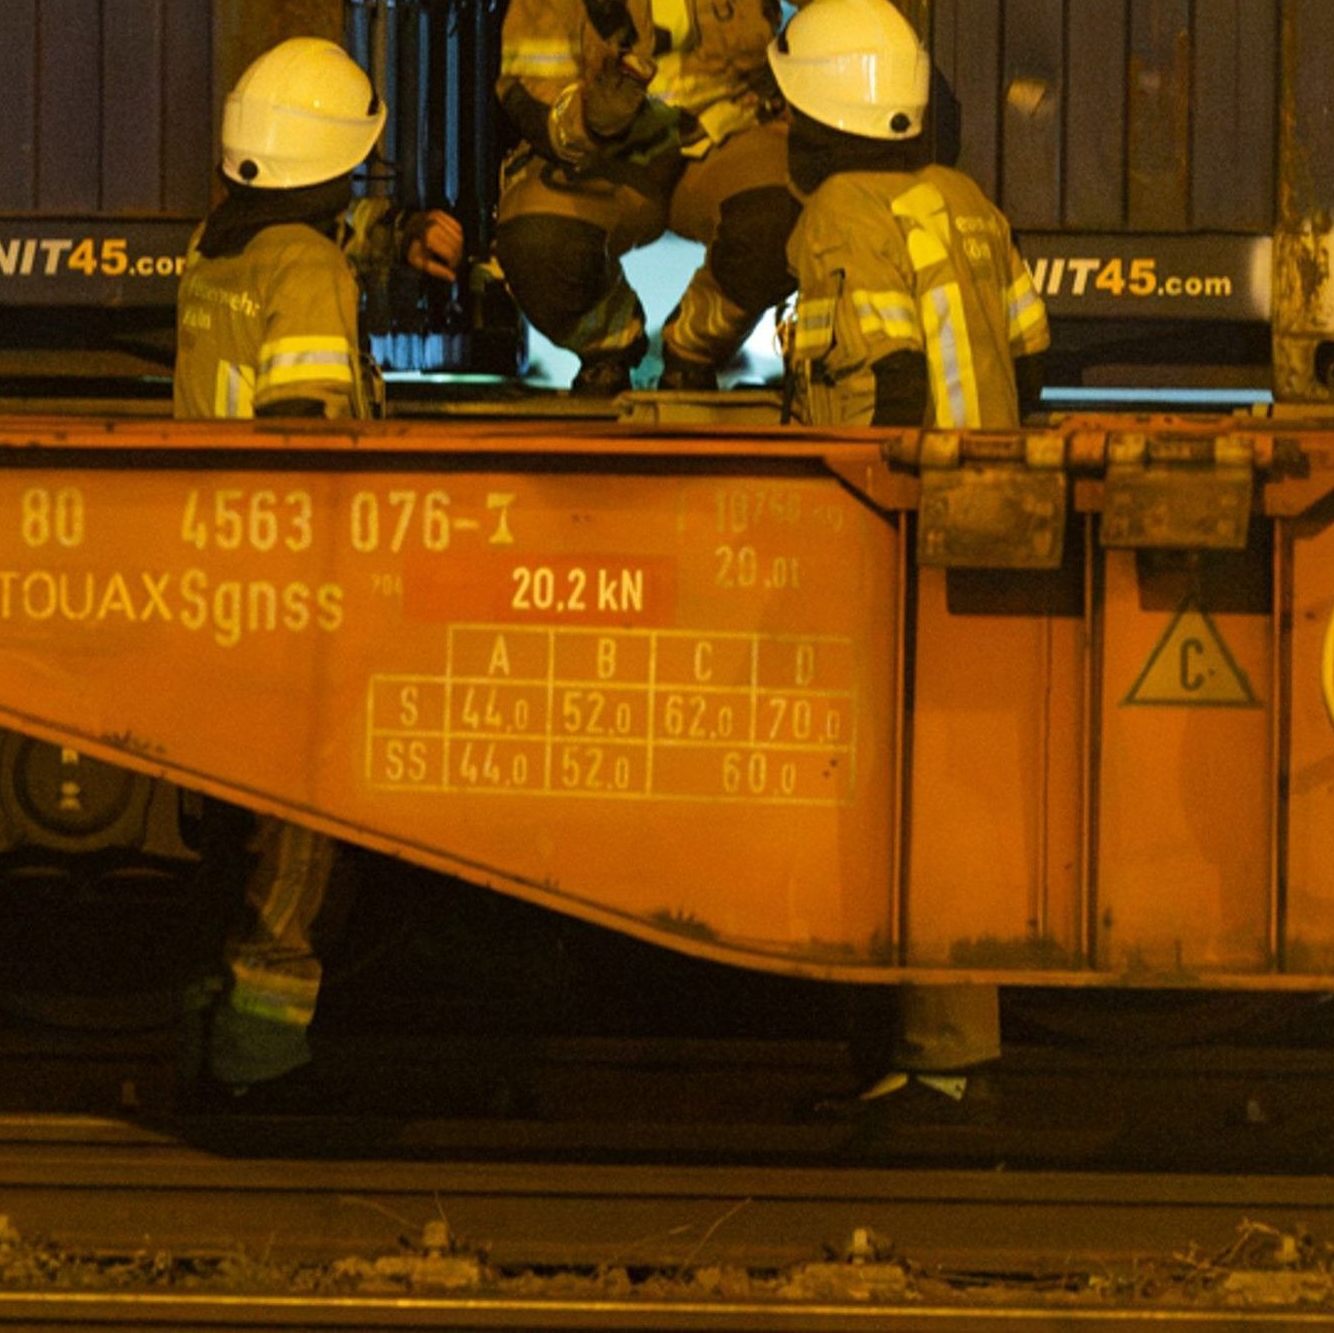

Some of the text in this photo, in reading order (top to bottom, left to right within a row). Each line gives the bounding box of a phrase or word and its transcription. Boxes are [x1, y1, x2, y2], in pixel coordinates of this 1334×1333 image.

[21, 486, 85, 548] 80
[180, 488, 313, 552] 4563
[179, 568, 344, 647] Sgnss
[598, 568, 644, 611] kN
[488, 633, 511, 676] A
[596, 637, 616, 679] B
[694, 640, 713, 682] C
[1180, 636, 1205, 692] C
[400, 684, 417, 727] S
[386, 739, 426, 781] SS
